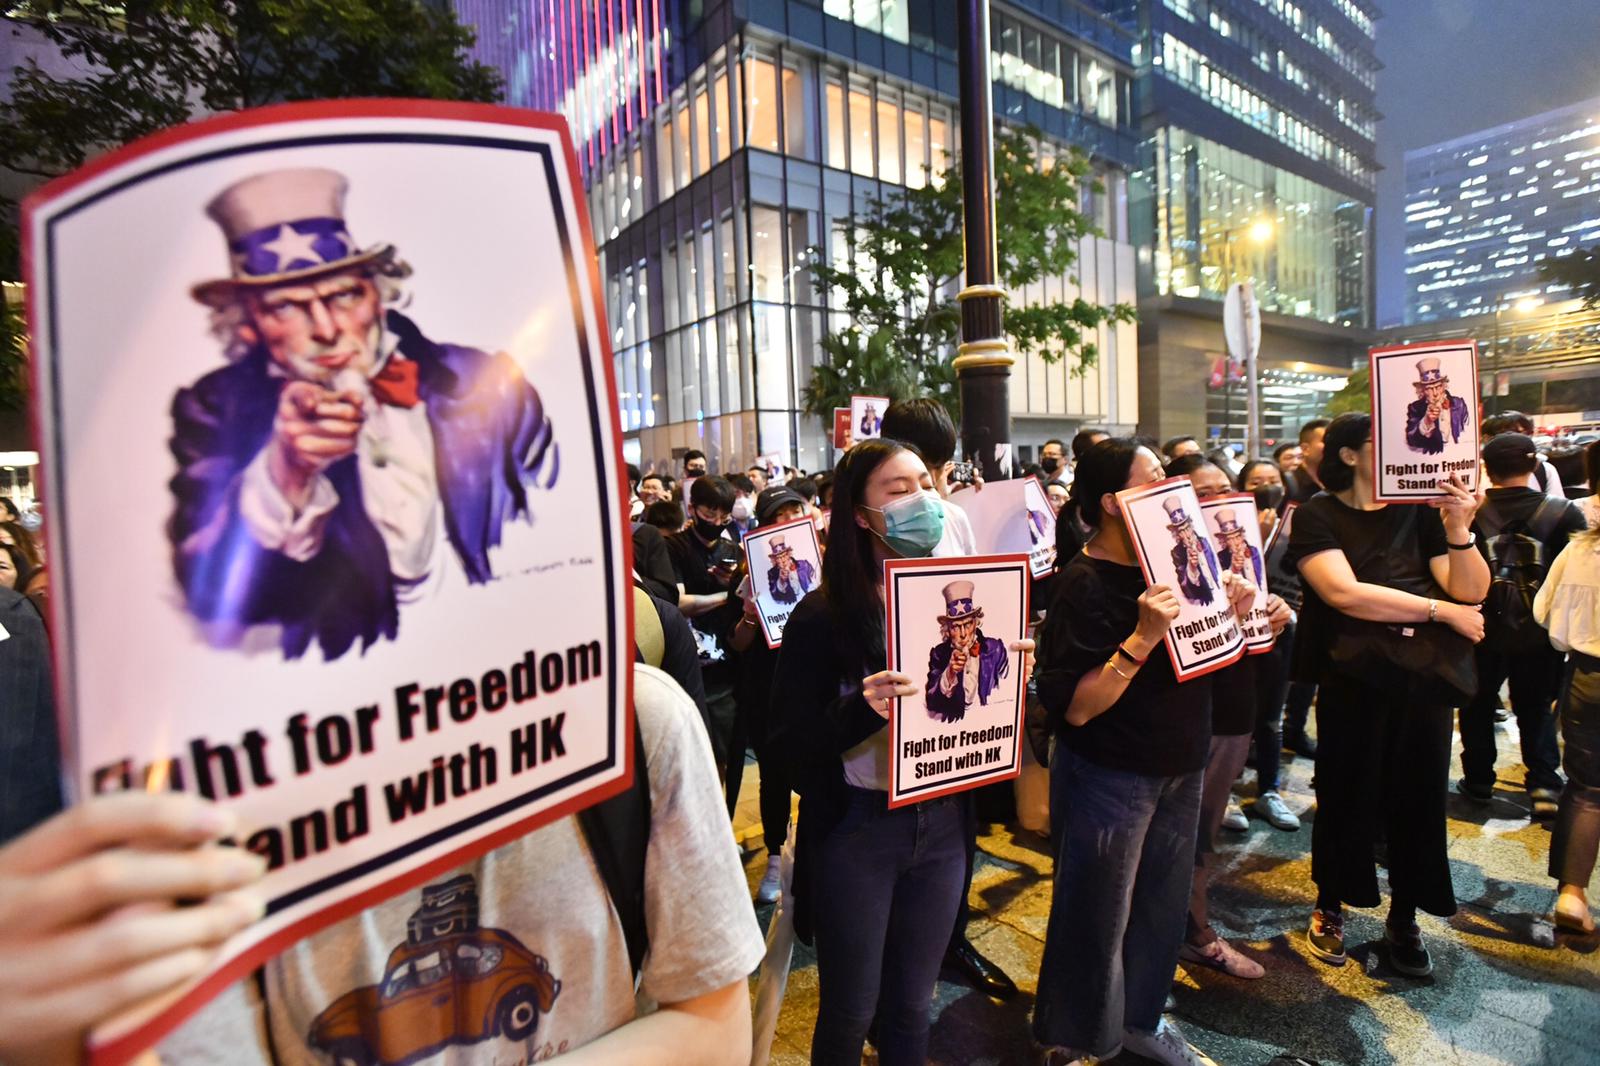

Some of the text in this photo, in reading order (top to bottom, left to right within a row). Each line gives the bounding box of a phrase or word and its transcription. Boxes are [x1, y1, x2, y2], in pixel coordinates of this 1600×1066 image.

[1385, 458, 1475, 476] Fight for Freedom
[1397, 478, 1436, 489] Stand
[767, 613, 787, 624] Fight
[1174, 619, 1206, 640] Fight
[1204, 615, 1219, 629] for
[1192, 632, 1225, 655] Stand
[286, 713, 379, 775] for
[395, 639, 602, 742] Freedom
[903, 724, 1013, 759] Fight for Freedom
[915, 746, 1002, 779] Stand with HK
[217, 711, 567, 872] and with HK
